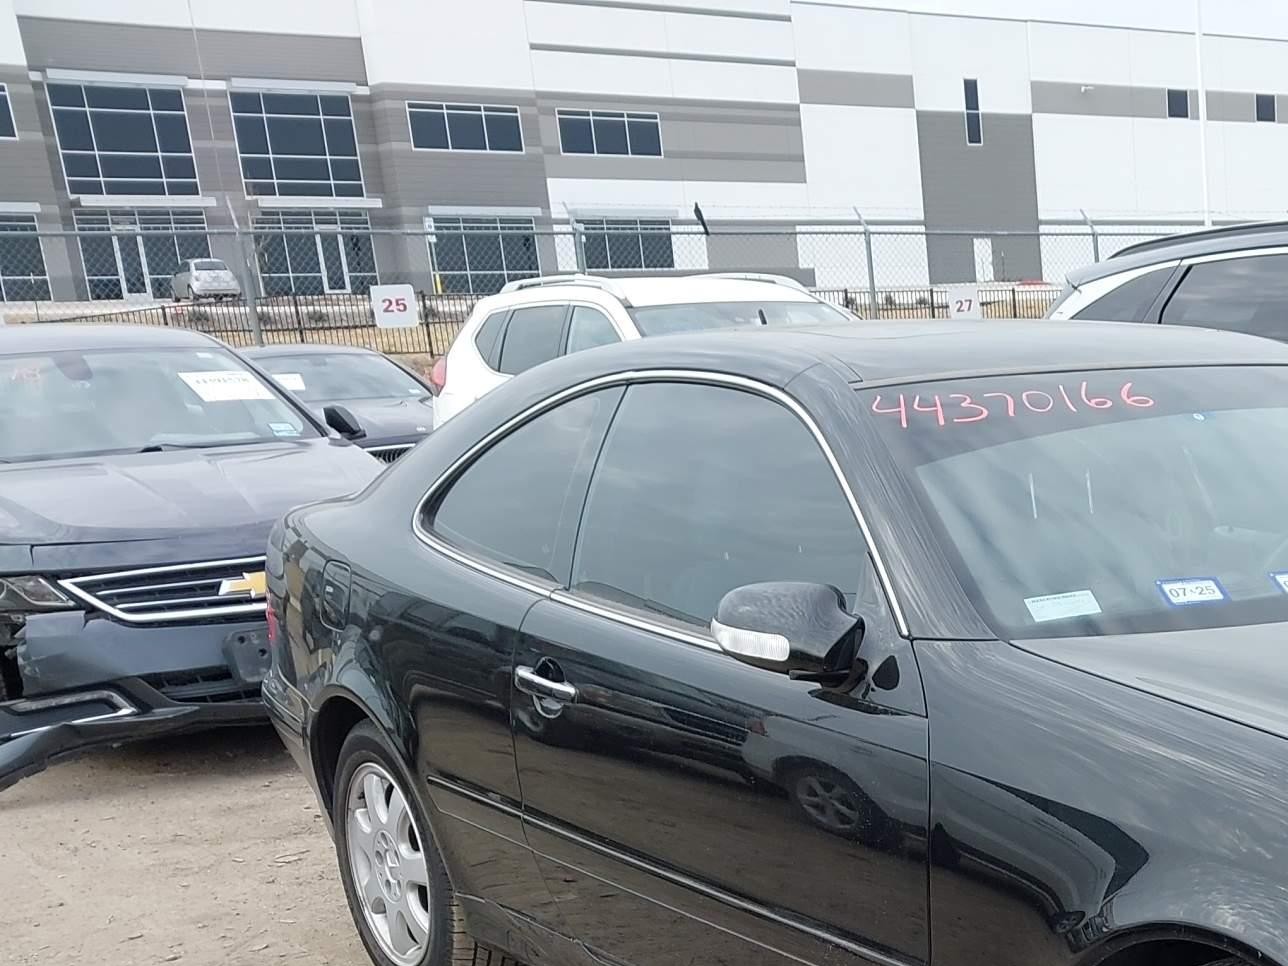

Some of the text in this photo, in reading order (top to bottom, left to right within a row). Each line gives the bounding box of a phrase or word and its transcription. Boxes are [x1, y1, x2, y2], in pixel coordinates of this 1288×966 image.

[381, 297, 408, 313] 25
[955, 298, 973, 313] 27
[871, 381, 1155, 429] 44370166
